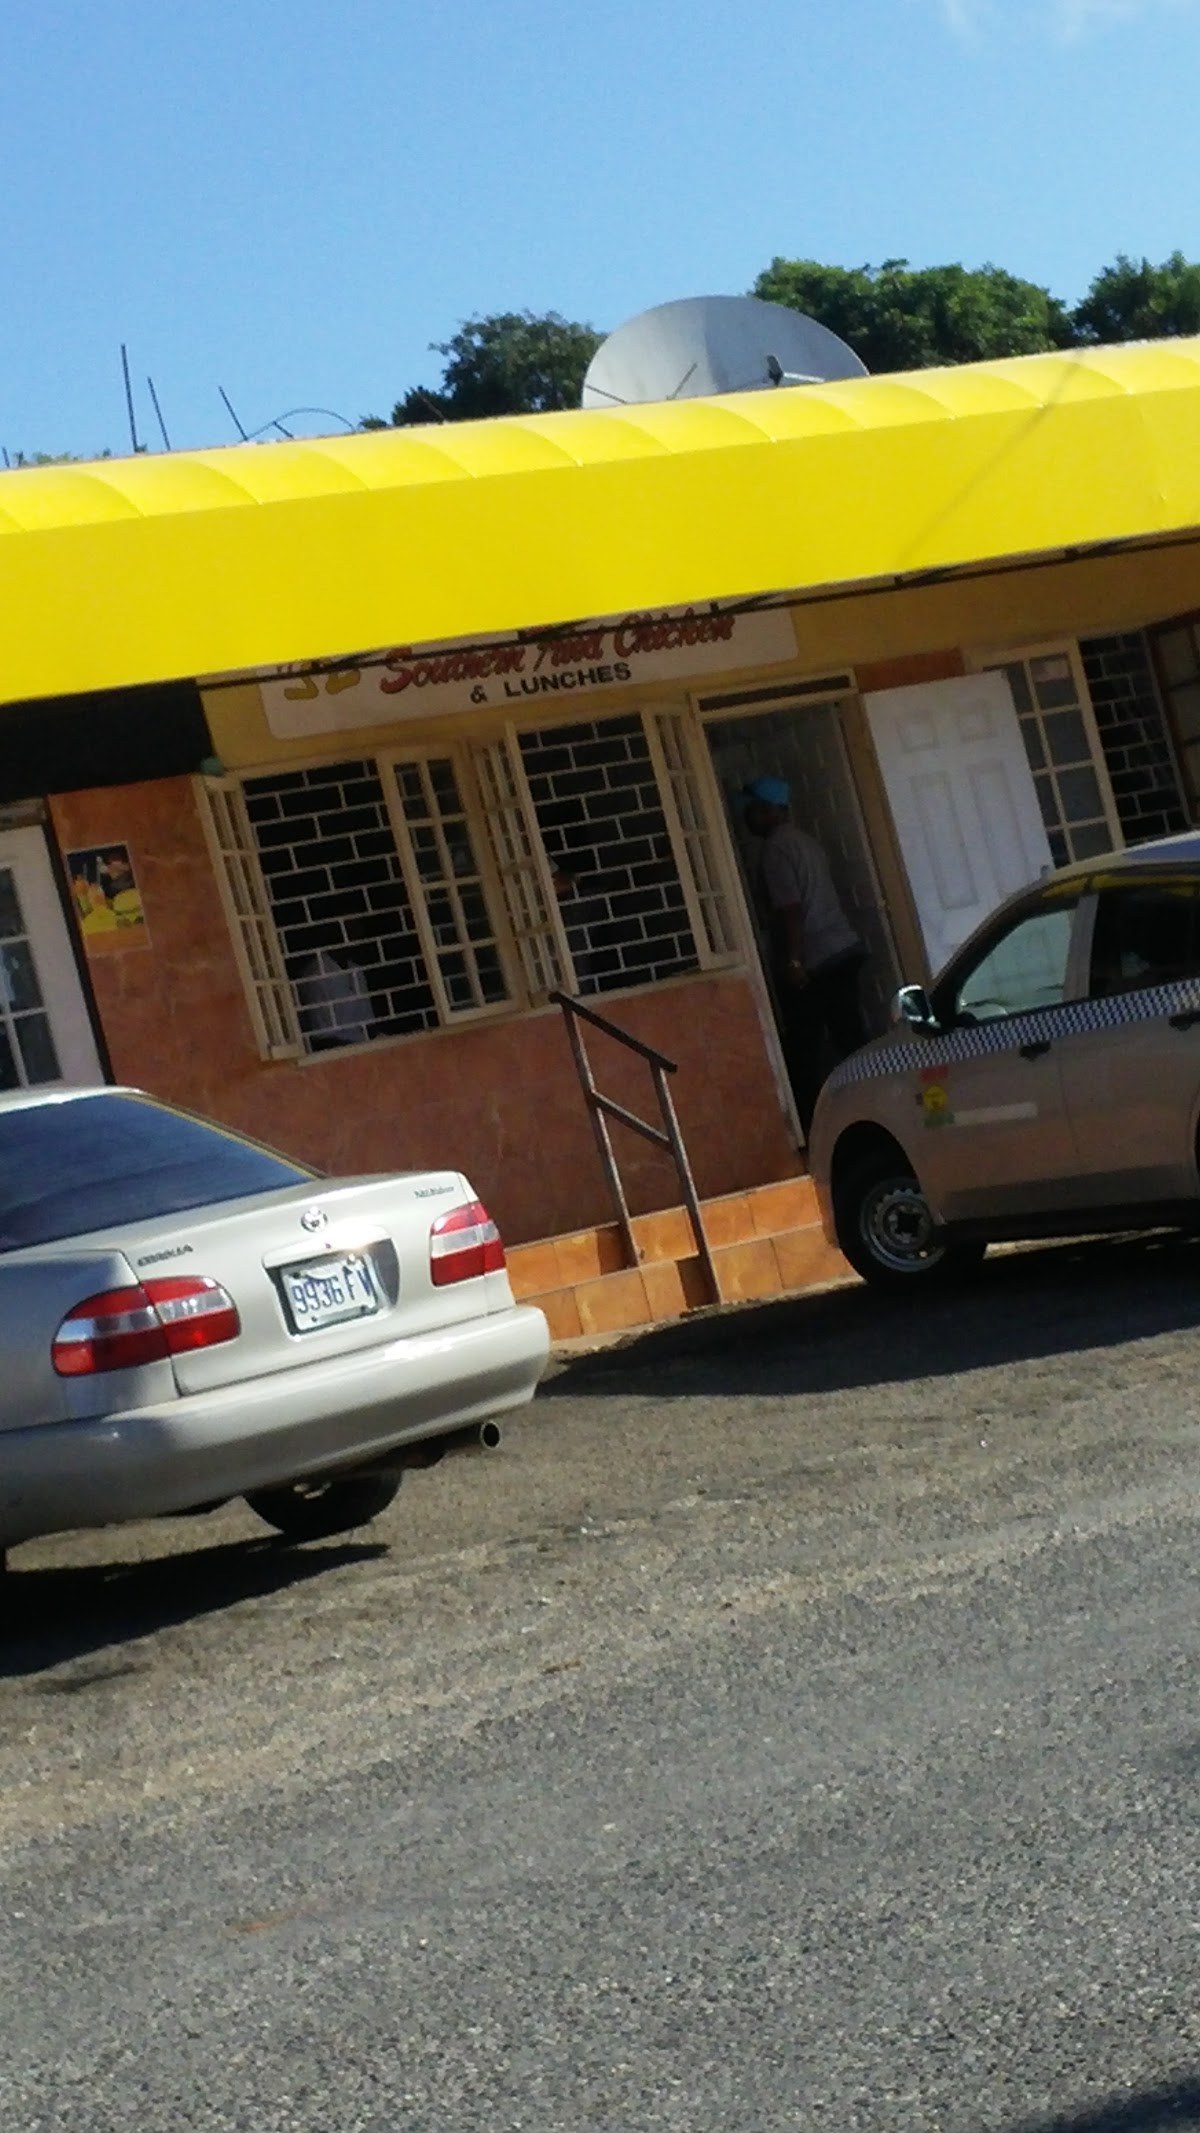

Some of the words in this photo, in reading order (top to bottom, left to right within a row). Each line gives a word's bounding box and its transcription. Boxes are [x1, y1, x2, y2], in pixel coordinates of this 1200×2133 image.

[613, 607, 736, 658] Chicken
[470, 685, 488, 704] &
[503, 661, 632, 698] LUNCHES
